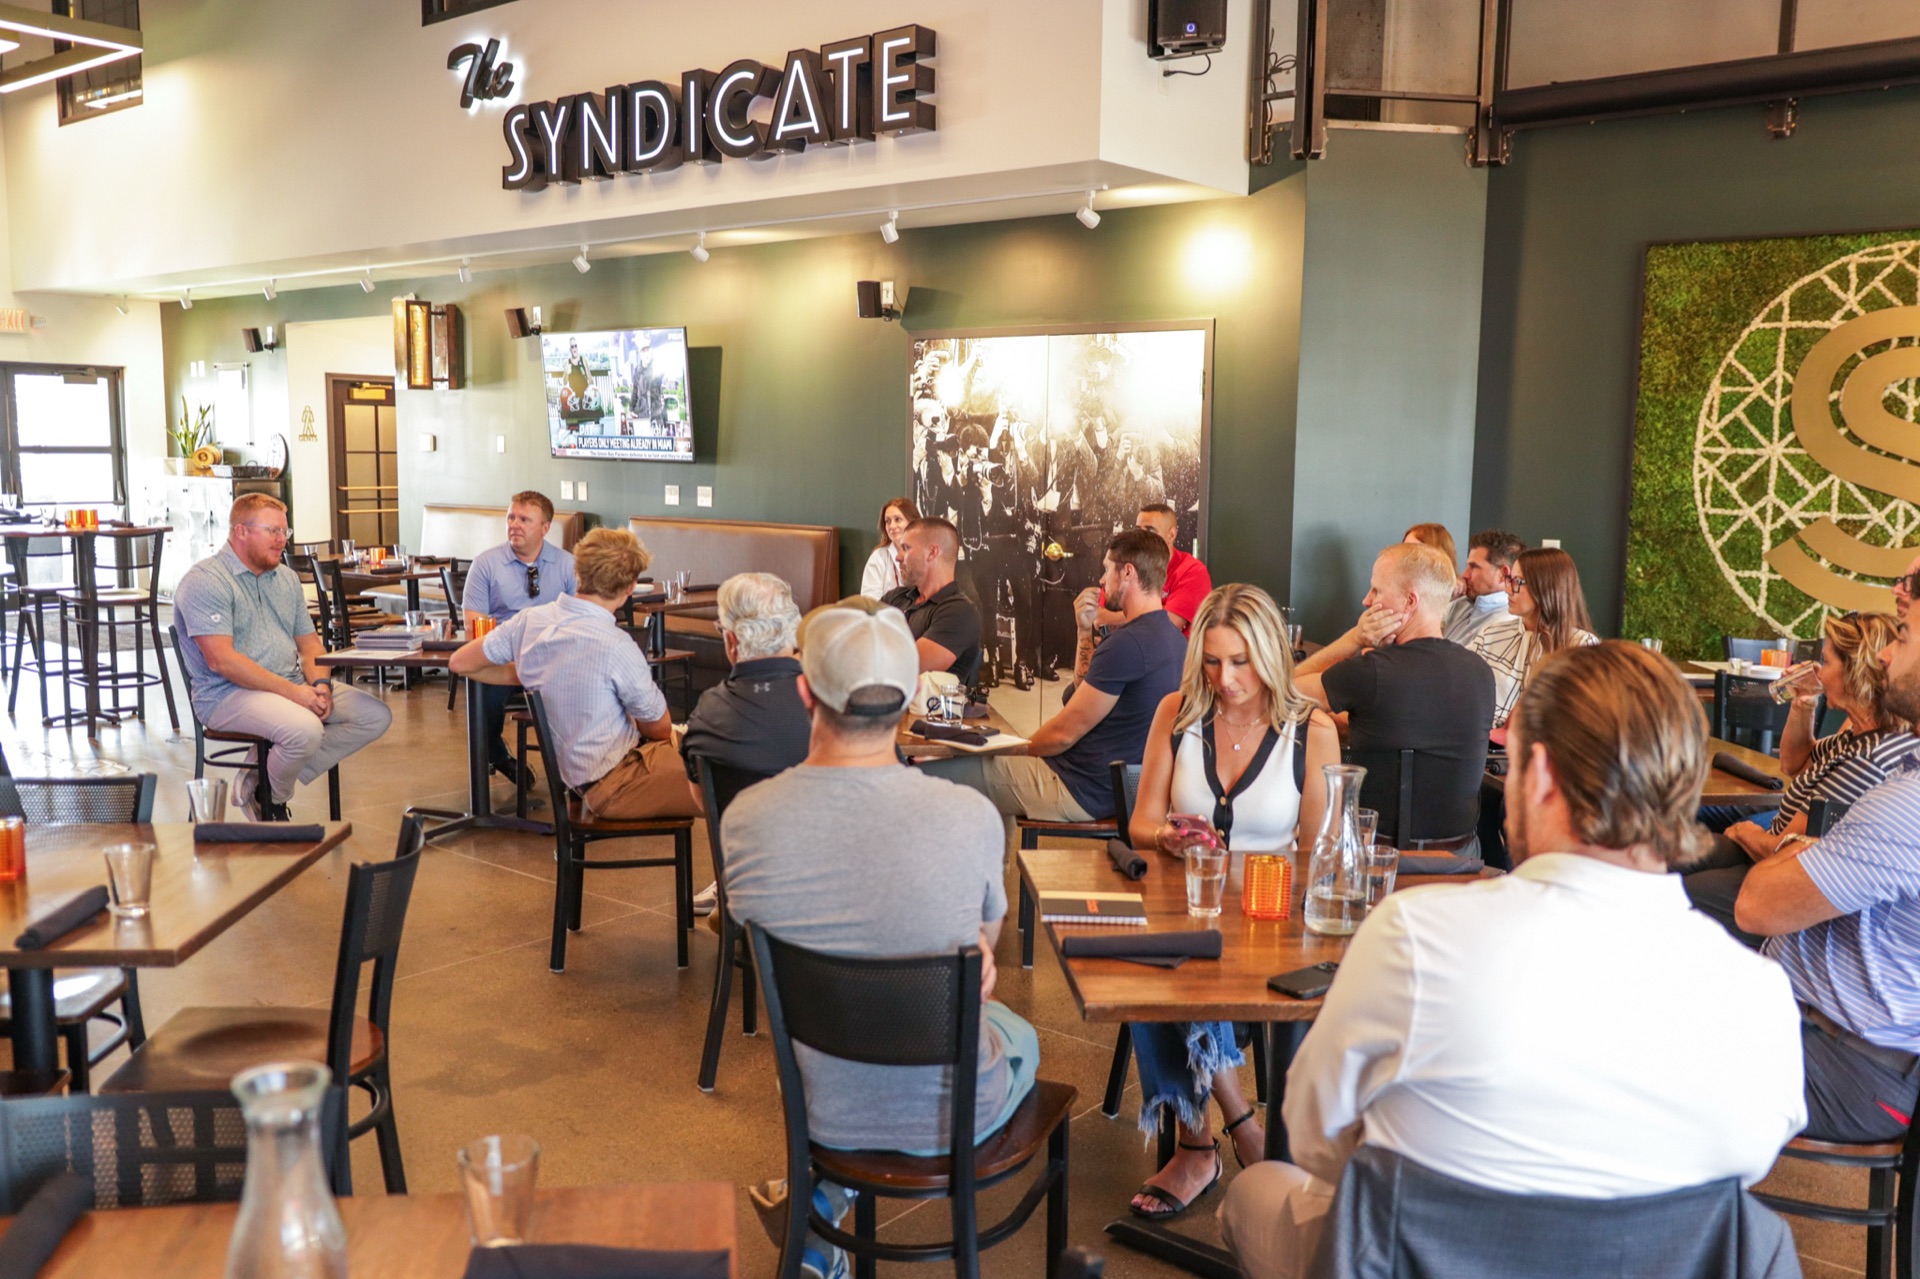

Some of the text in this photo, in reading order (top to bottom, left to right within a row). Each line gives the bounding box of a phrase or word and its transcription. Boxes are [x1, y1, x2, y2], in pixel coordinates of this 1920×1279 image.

[447, 37, 515, 109] The
[503, 24, 936, 190] SYNDICATE
[578, 437, 673, 451] PLAYERS ONLY MEETING ALREADY IN MIAMI
